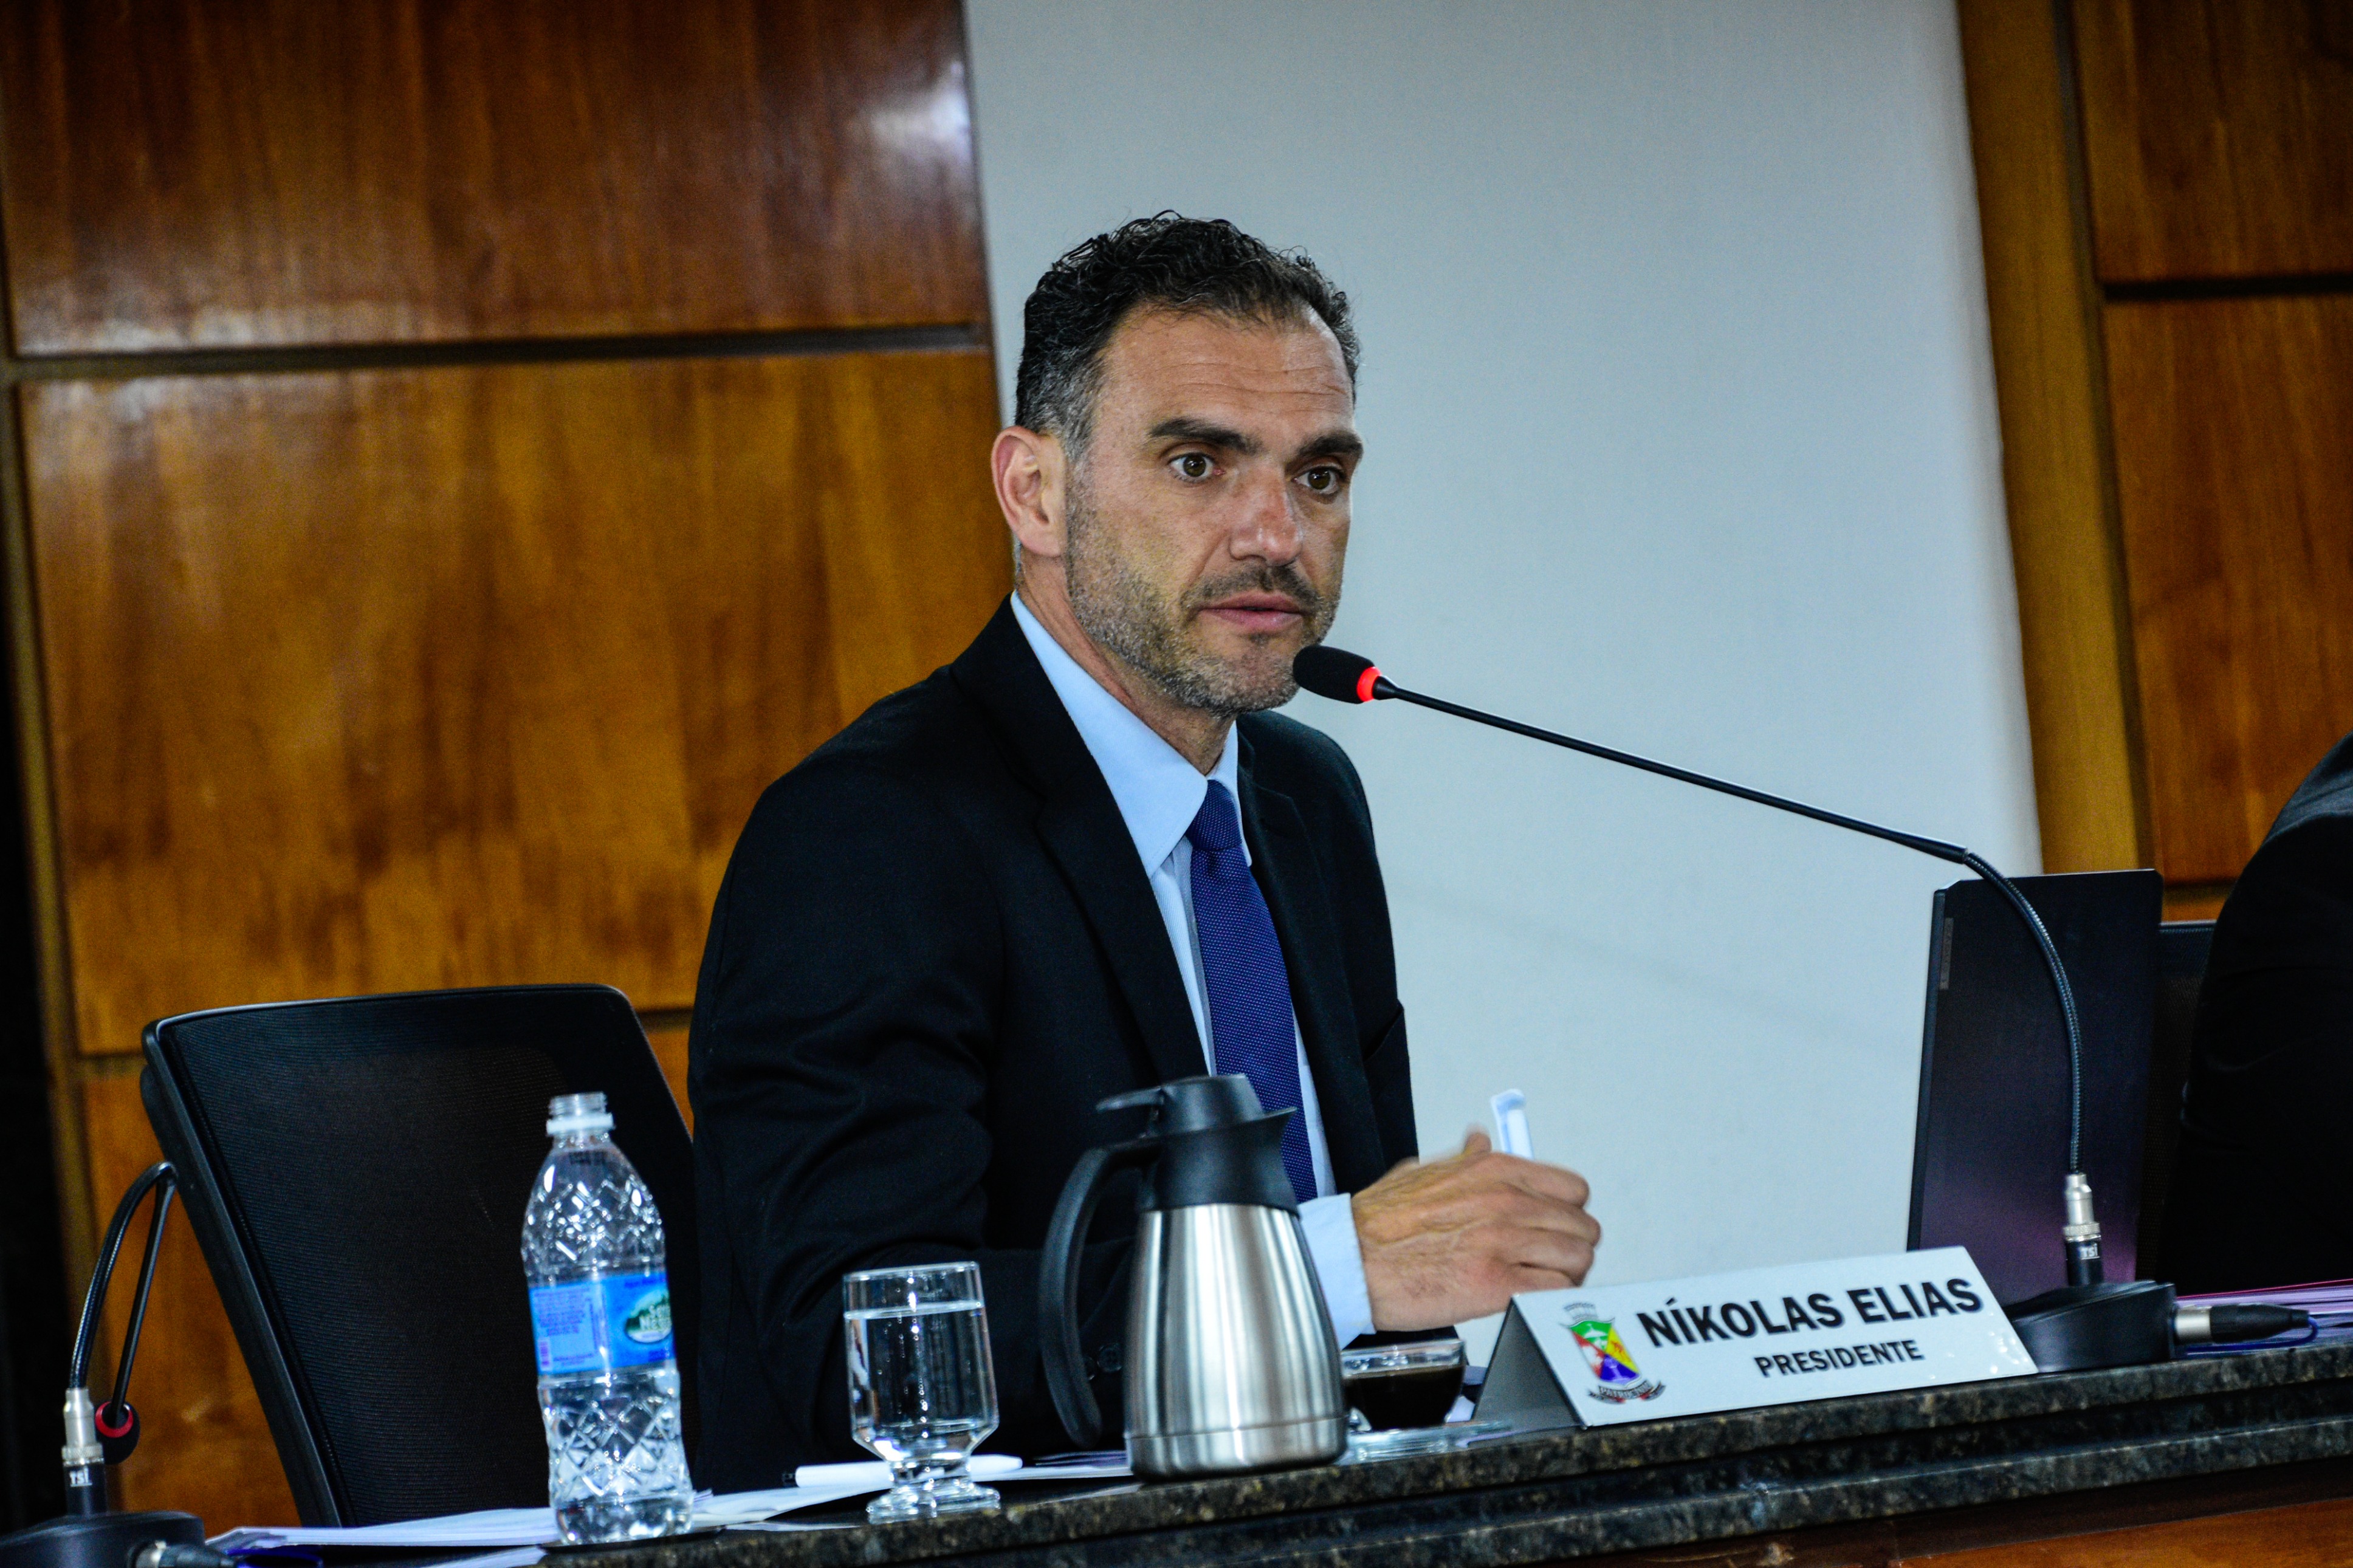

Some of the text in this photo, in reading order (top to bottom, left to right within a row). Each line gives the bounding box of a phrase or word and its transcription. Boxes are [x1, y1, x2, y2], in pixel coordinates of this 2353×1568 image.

[1637, 1278, 1984, 1347] NÍKOLAS ELIAS
[1754, 1340, 1925, 1378] PRESIDENTE
